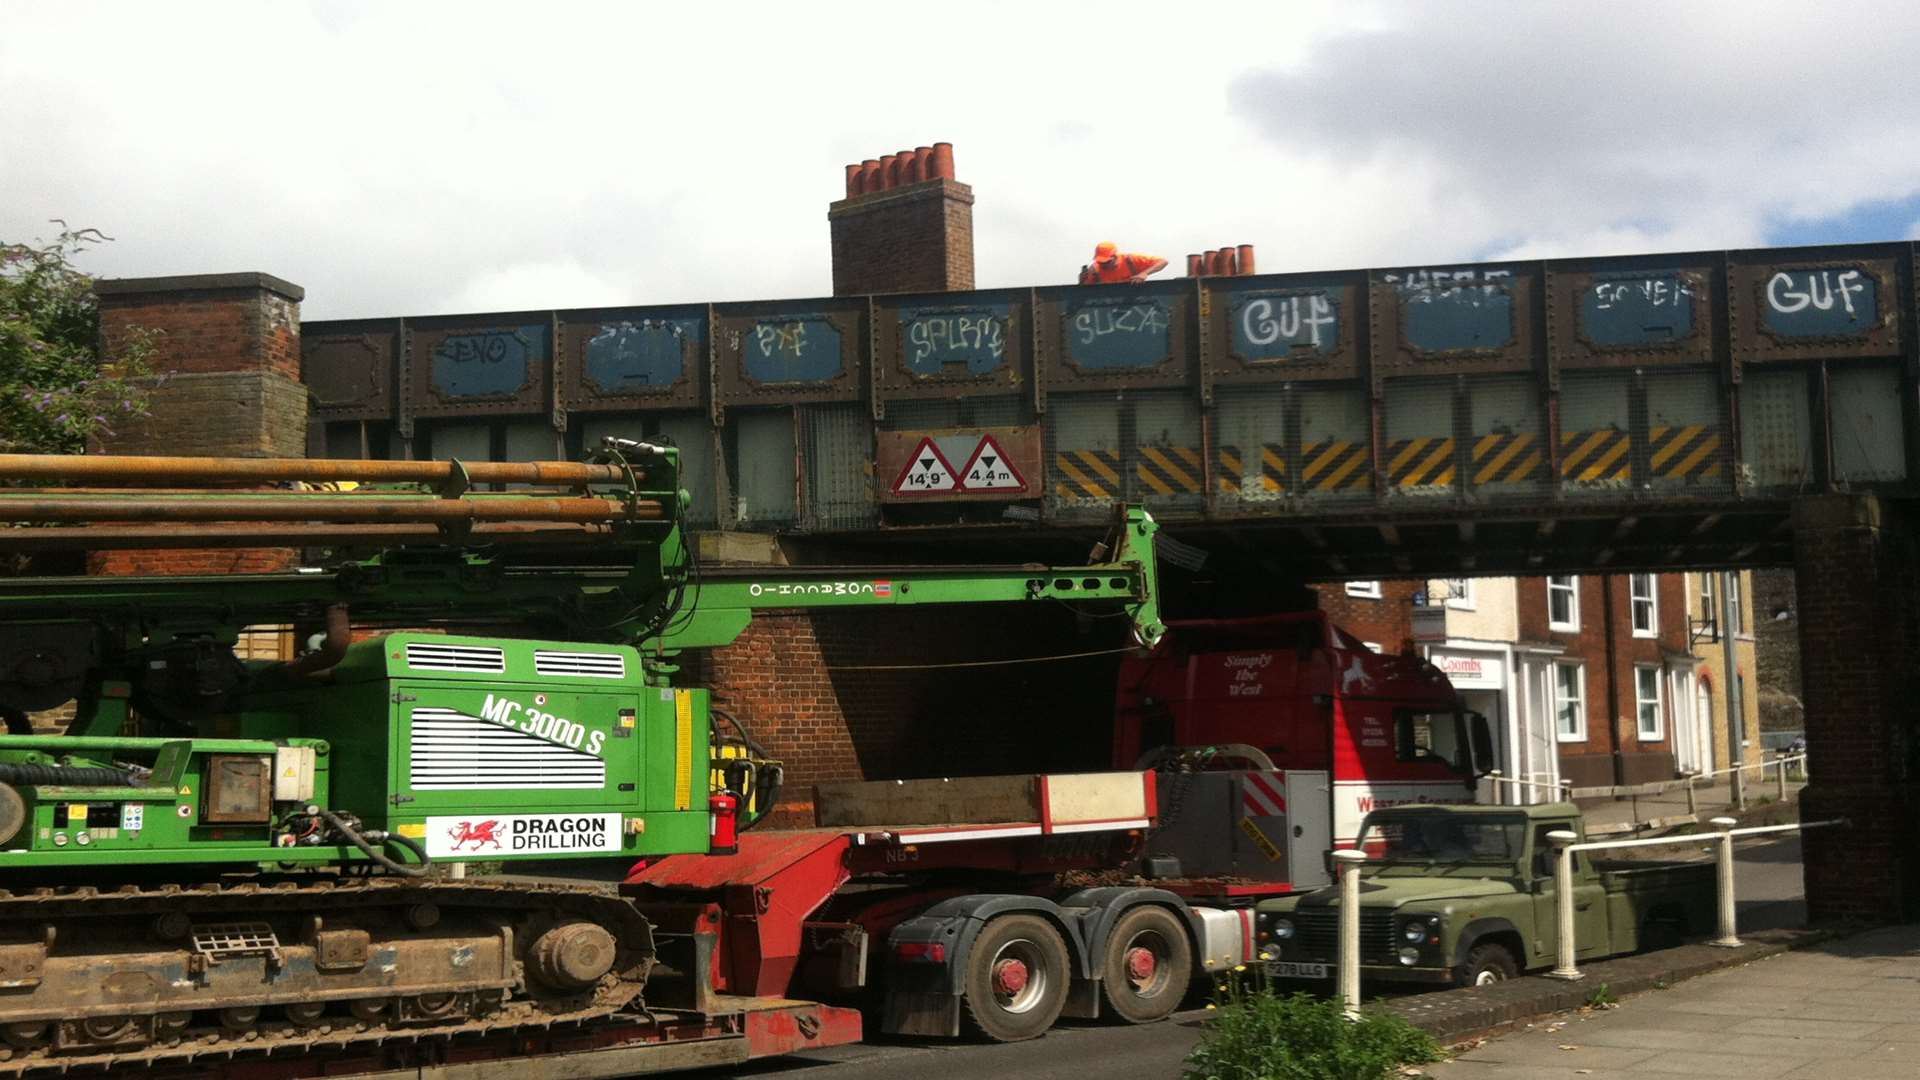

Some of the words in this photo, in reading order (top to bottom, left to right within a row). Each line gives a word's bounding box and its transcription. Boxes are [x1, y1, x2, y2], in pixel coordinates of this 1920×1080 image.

[1767, 270, 1863, 312] GUF
[1244, 295, 1335, 348] GUF
[1224, 653, 1272, 669] Simply
[1234, 668, 1259, 681] the
[1229, 683, 1263, 696] West
[480, 693, 522, 727] MC
[520, 708, 586, 749] 3000
[586, 729, 606, 755] S
[512, 818, 606, 834] DRAGON
[512, 833, 606, 850] DRILLING
